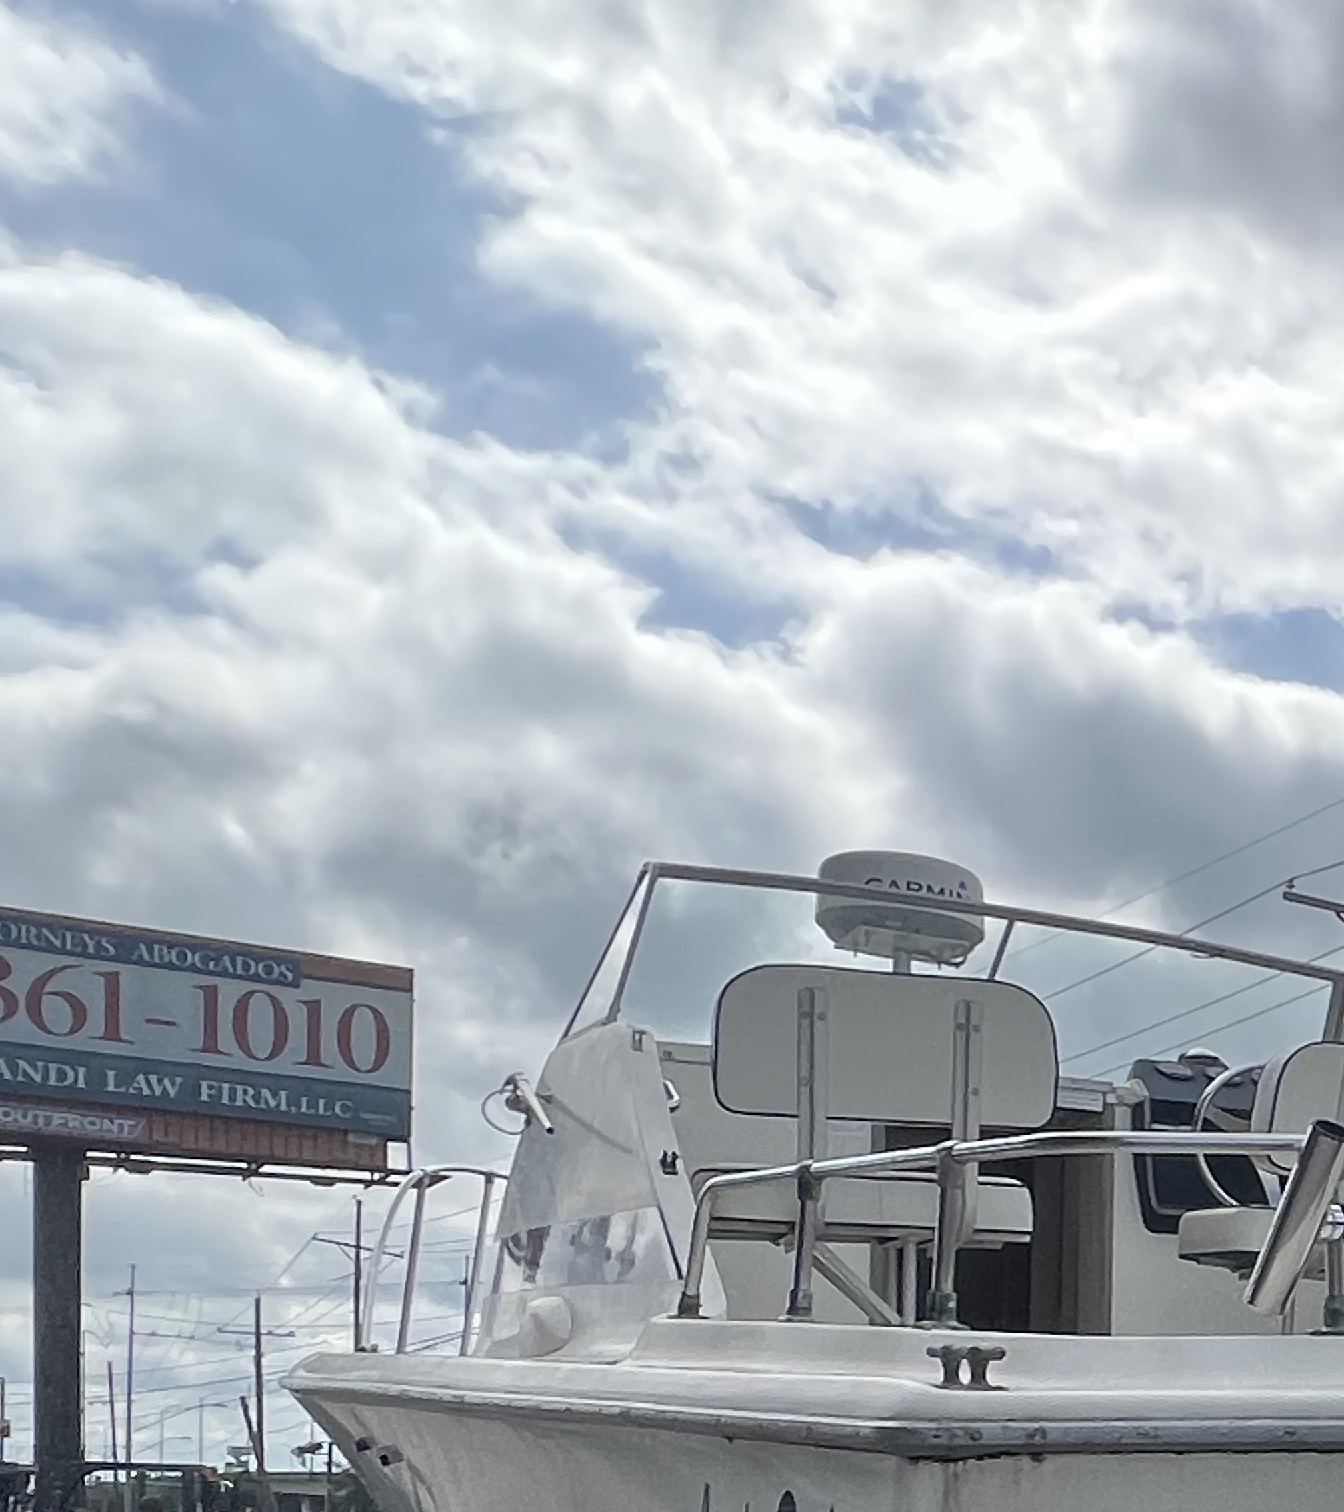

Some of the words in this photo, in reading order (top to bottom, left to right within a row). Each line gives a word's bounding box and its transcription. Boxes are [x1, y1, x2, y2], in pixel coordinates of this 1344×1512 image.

[131, 942, 294, 983] ABOGADOS
[103, 1068, 184, 1099] LAW
[199, 1079, 296, 1114] FIRM,
[300, 1096, 355, 1118] LLC
[0, 1106, 136, 1137] OUTFRONT
